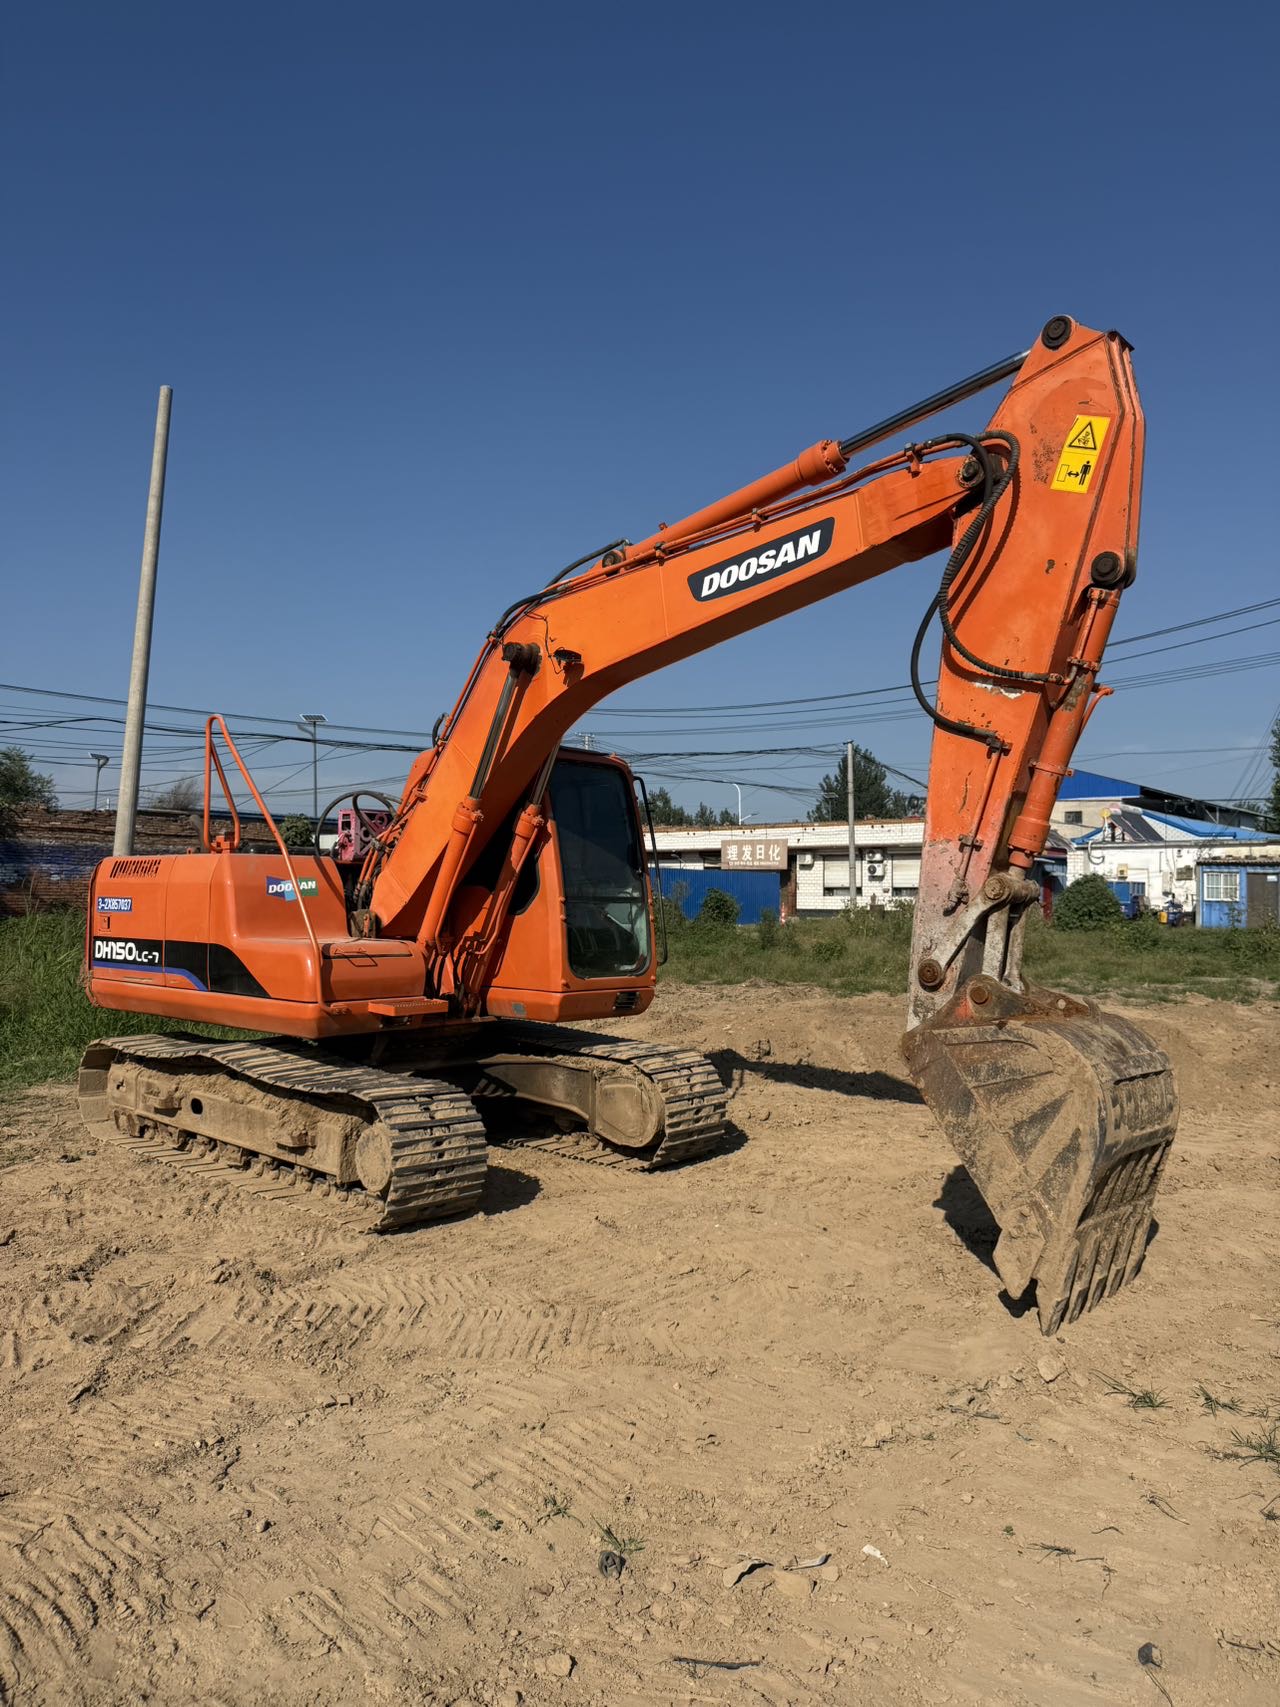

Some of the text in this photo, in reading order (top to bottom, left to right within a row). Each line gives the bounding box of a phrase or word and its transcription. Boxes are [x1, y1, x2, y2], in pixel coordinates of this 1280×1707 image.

[701, 529, 821, 598] DOOSAN
[726, 844, 781, 861] 理发日化
[268, 880, 316, 894] DOOAN
